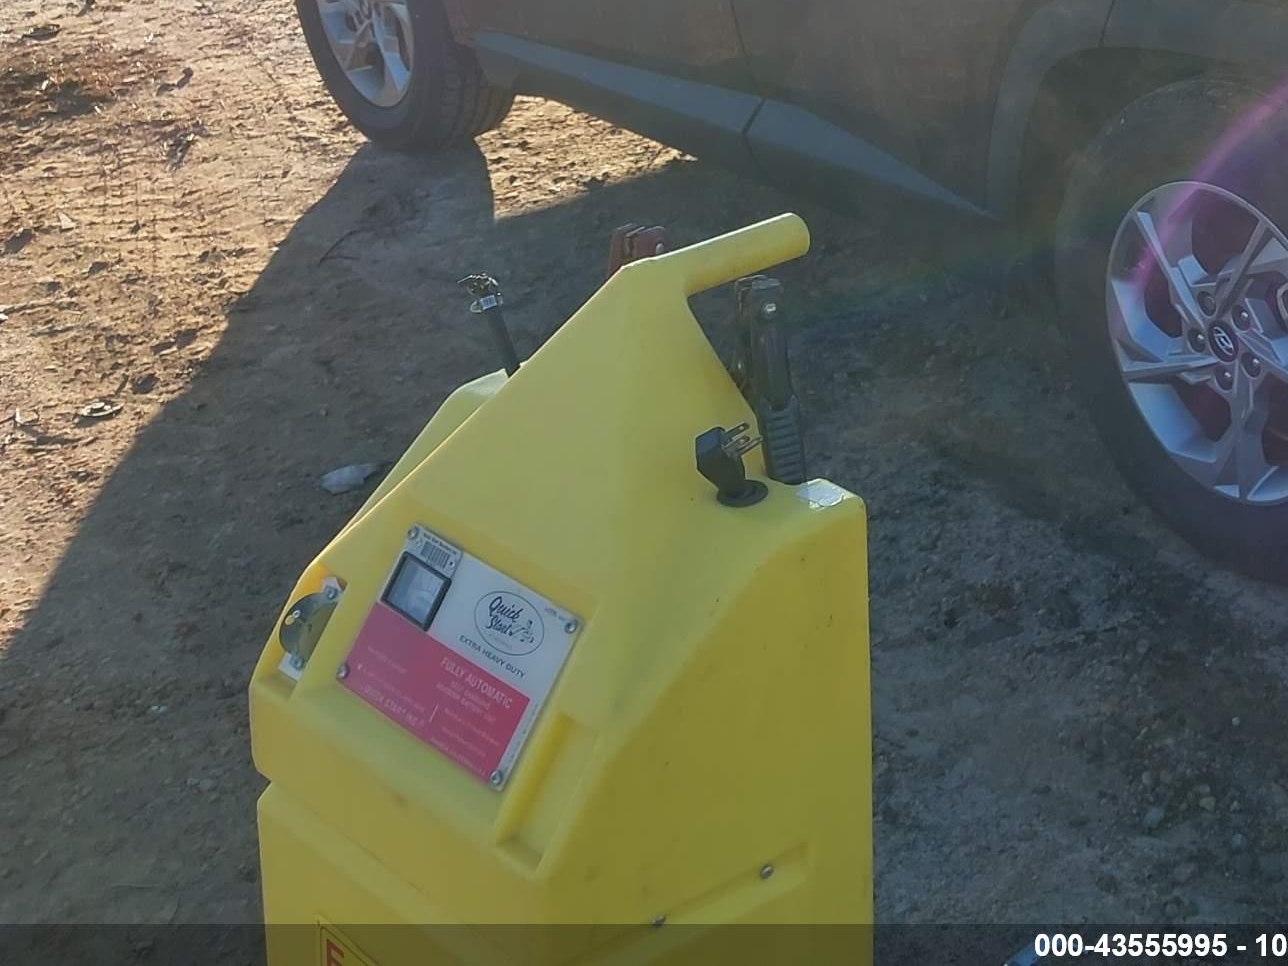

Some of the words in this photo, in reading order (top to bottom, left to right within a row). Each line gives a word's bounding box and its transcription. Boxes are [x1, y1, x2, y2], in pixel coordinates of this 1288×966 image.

[488, 595, 522, 622] Quick
[458, 635, 482, 653] EXTRA
[481, 649, 506, 668] HEAVY
[505, 663, 526, 679] DUTY
[440, 657, 467, 680] FULLY
[465, 672, 513, 709] AUTOMATIC
